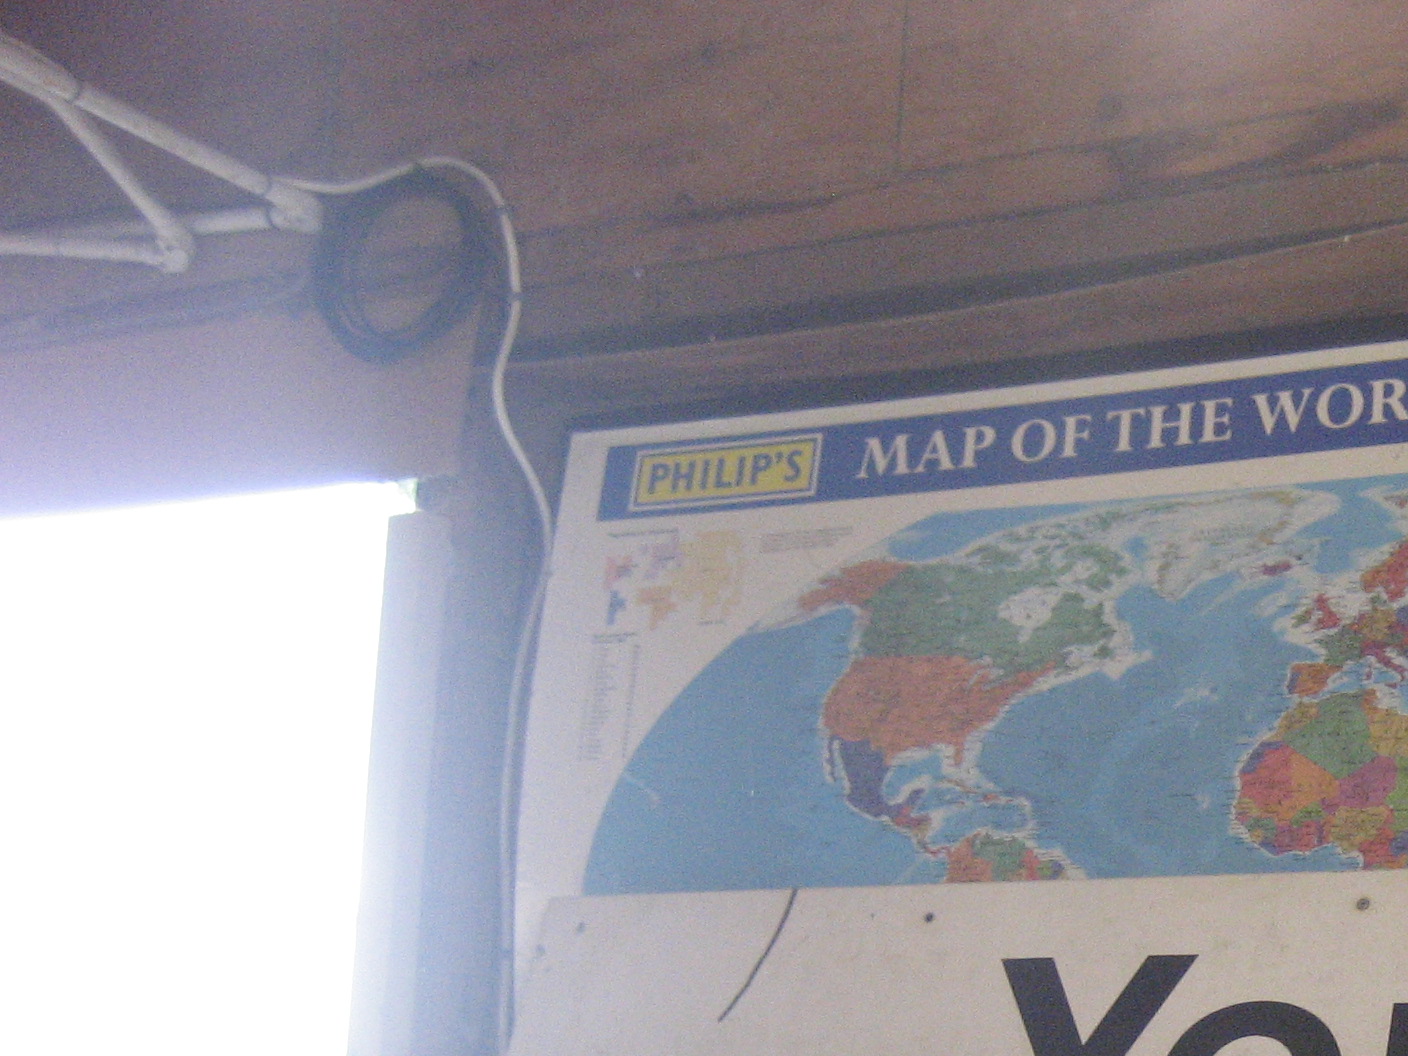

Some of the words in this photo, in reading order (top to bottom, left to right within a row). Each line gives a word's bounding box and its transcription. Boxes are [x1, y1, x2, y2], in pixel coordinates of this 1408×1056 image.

[855, 425, 997, 479] MAP
[1011, 414, 1093, 462] OF
[1106, 397, 1234, 452] THE
[647, 450, 804, 494] PHILIP'S
